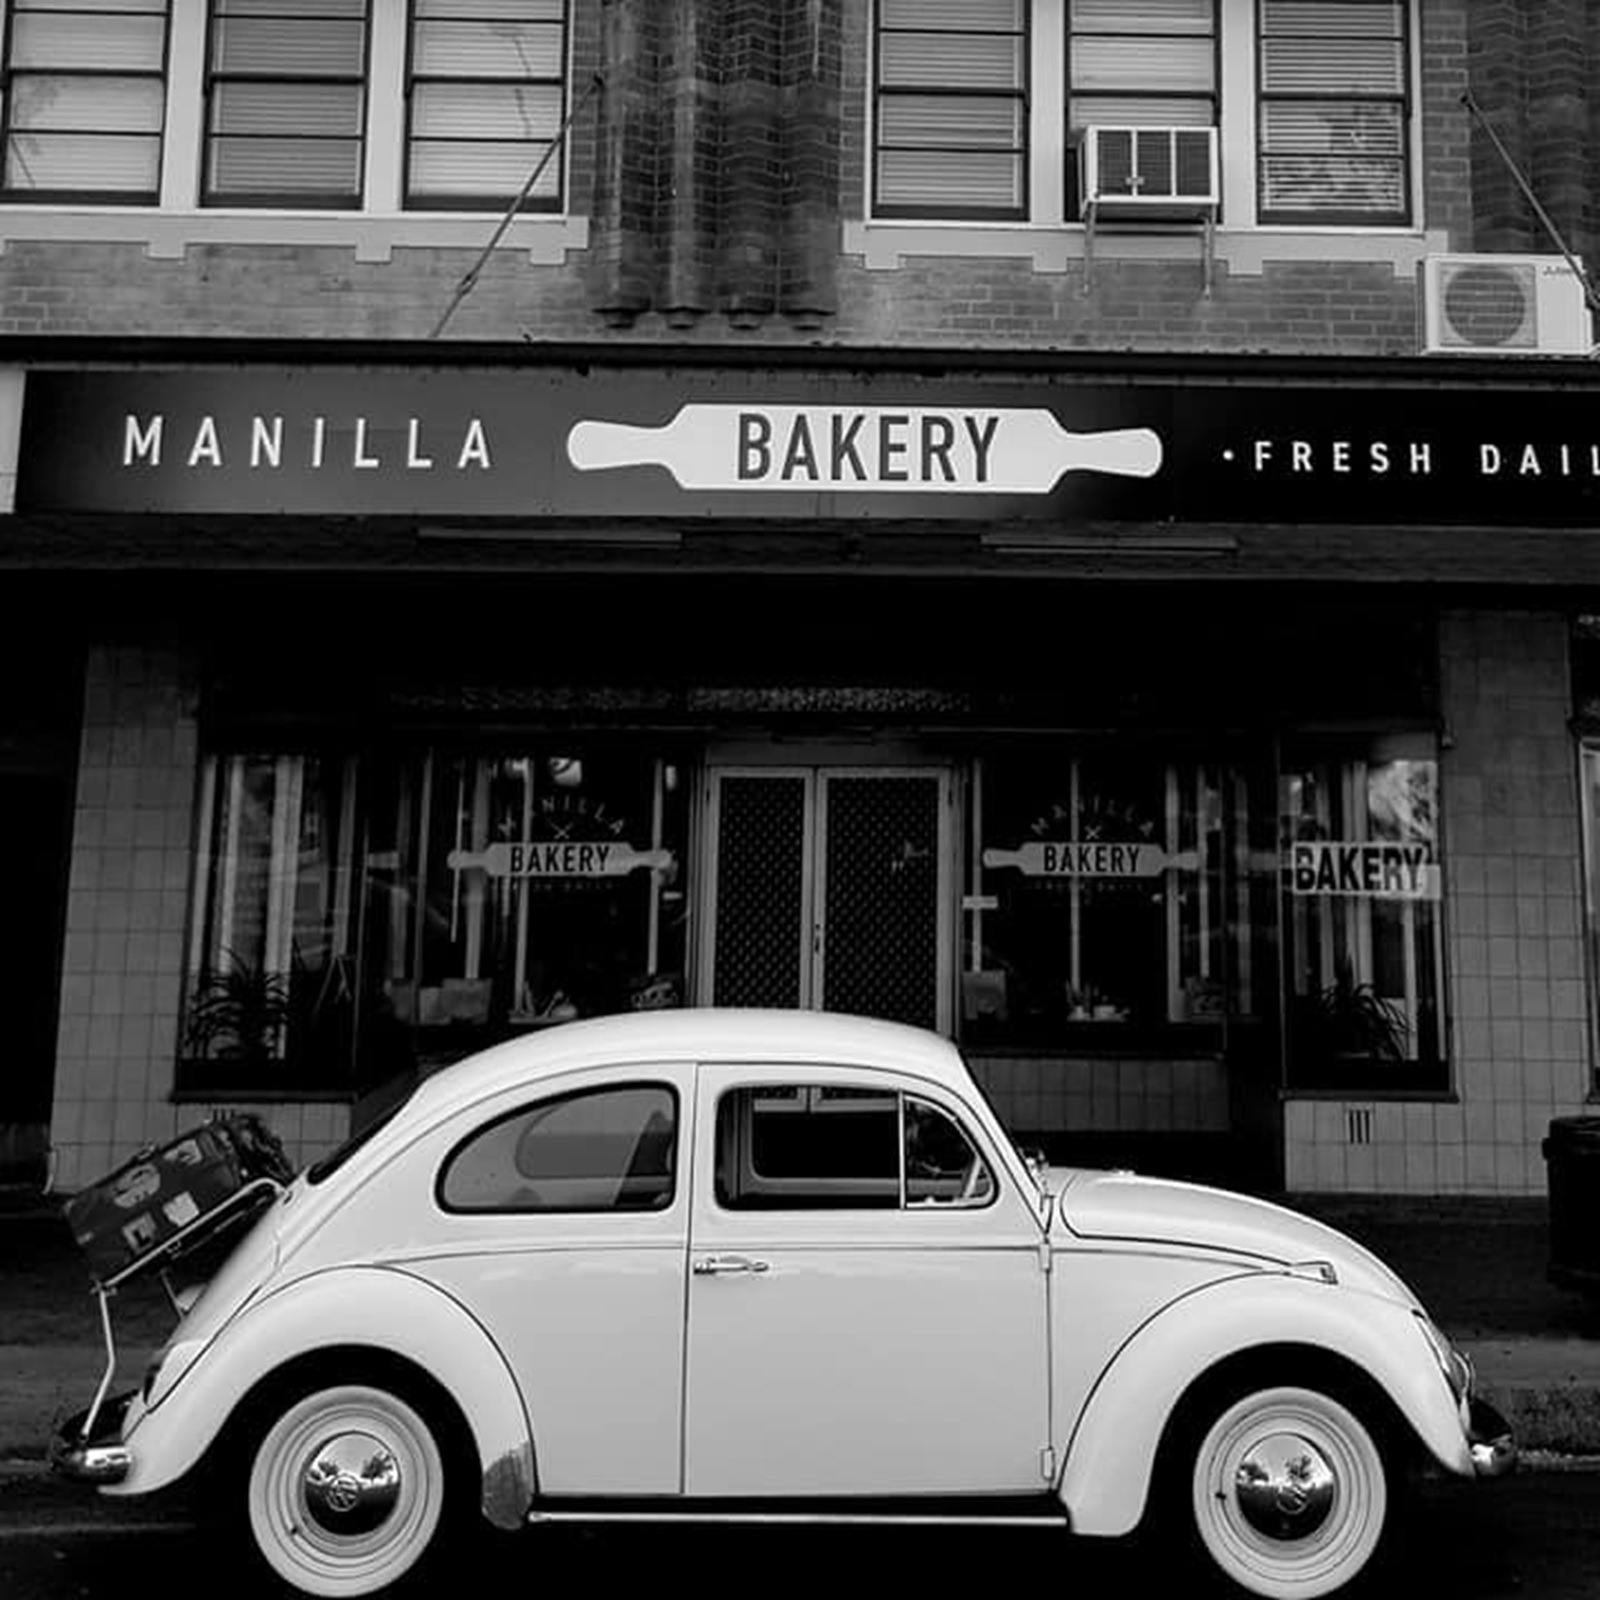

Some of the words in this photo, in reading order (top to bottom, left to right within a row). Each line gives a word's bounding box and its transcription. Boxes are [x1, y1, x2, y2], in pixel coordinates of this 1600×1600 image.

[123, 414, 491, 470] MANILLA
[738, 413, 999, 482] BAKERY
[1254, 440, 1431, 473] FRESH
[497, 793, 626, 837] MNILLA
[510, 845, 610, 873] BAKERY
[1043, 845, 1141, 873] BAKERY
[1294, 846, 1424, 891] BAKERY
